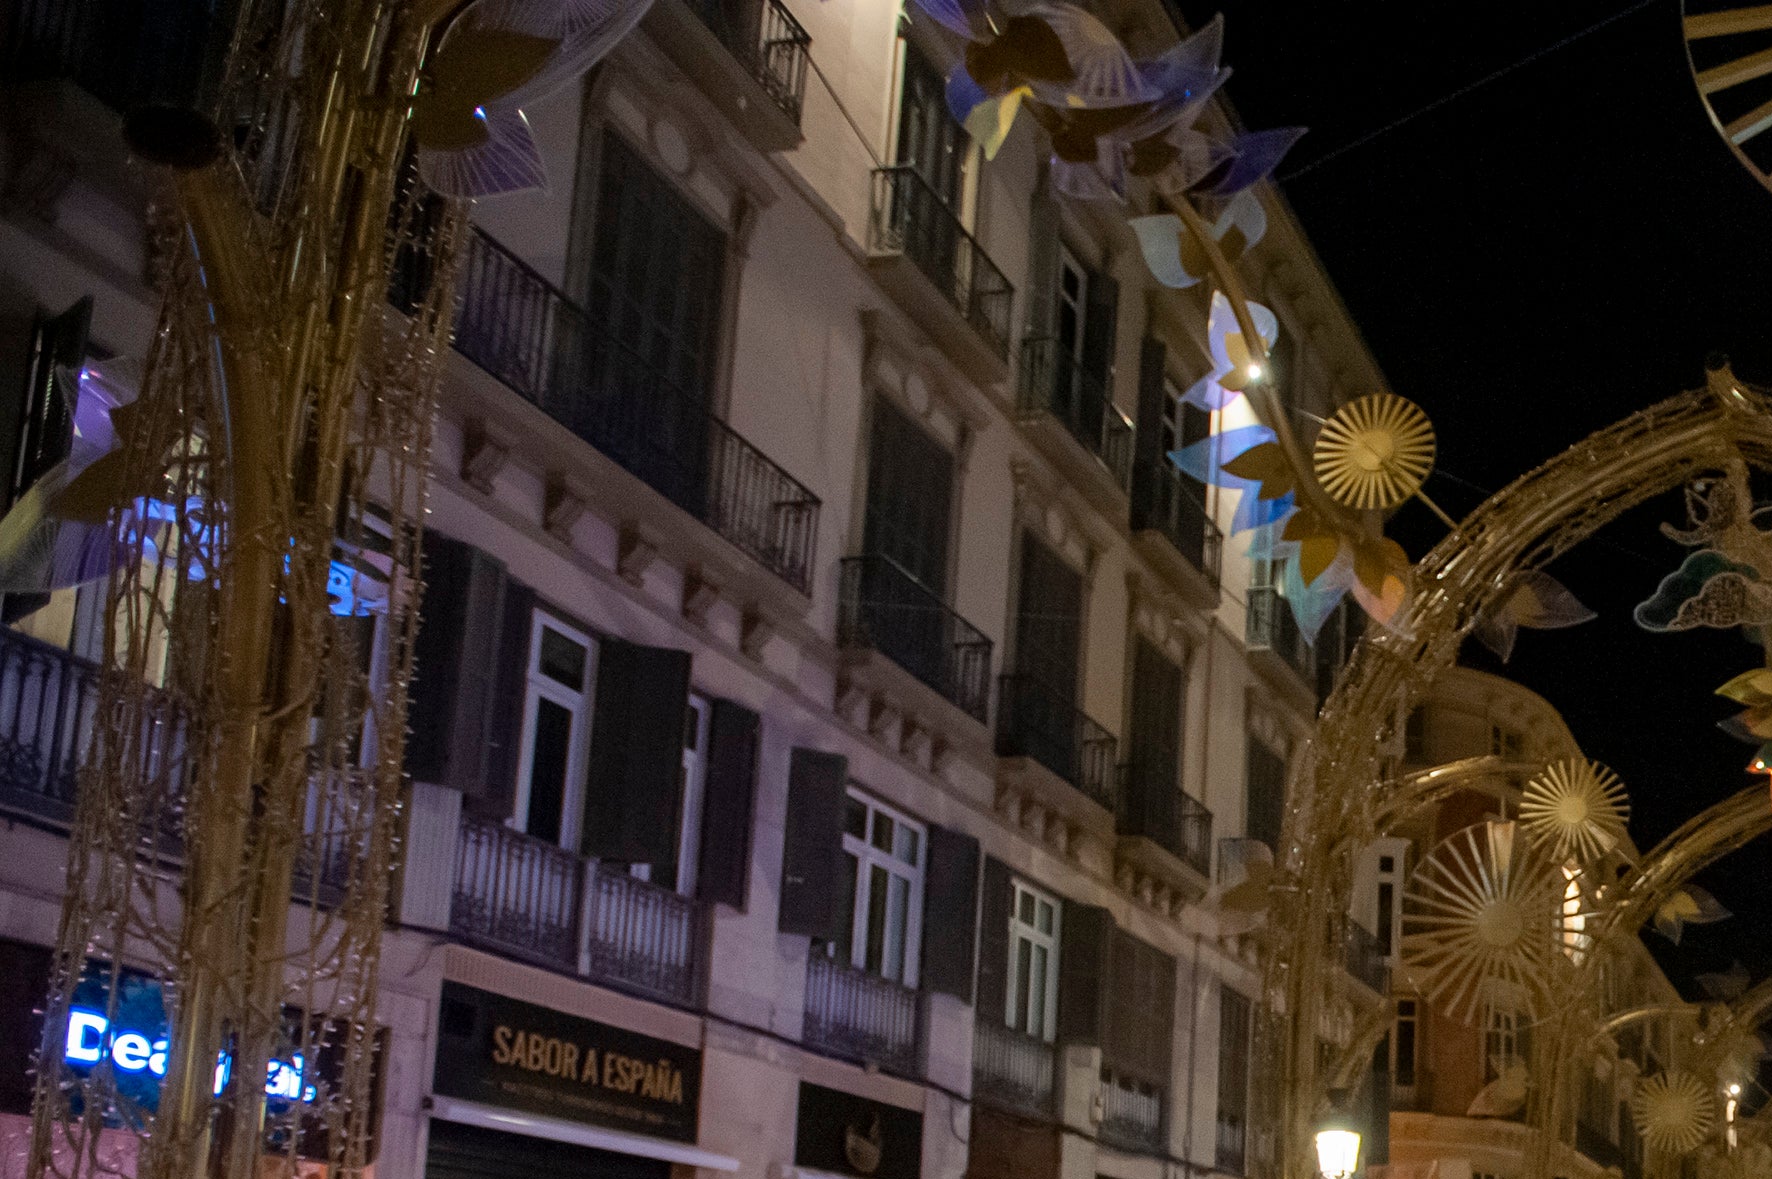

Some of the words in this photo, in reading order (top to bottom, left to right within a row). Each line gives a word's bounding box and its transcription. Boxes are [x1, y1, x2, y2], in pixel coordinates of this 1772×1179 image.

[491, 1025, 578, 1081] SABOR
[581, 1047, 598, 1086] A
[602, 1051, 683, 1105] ESPAÑA
